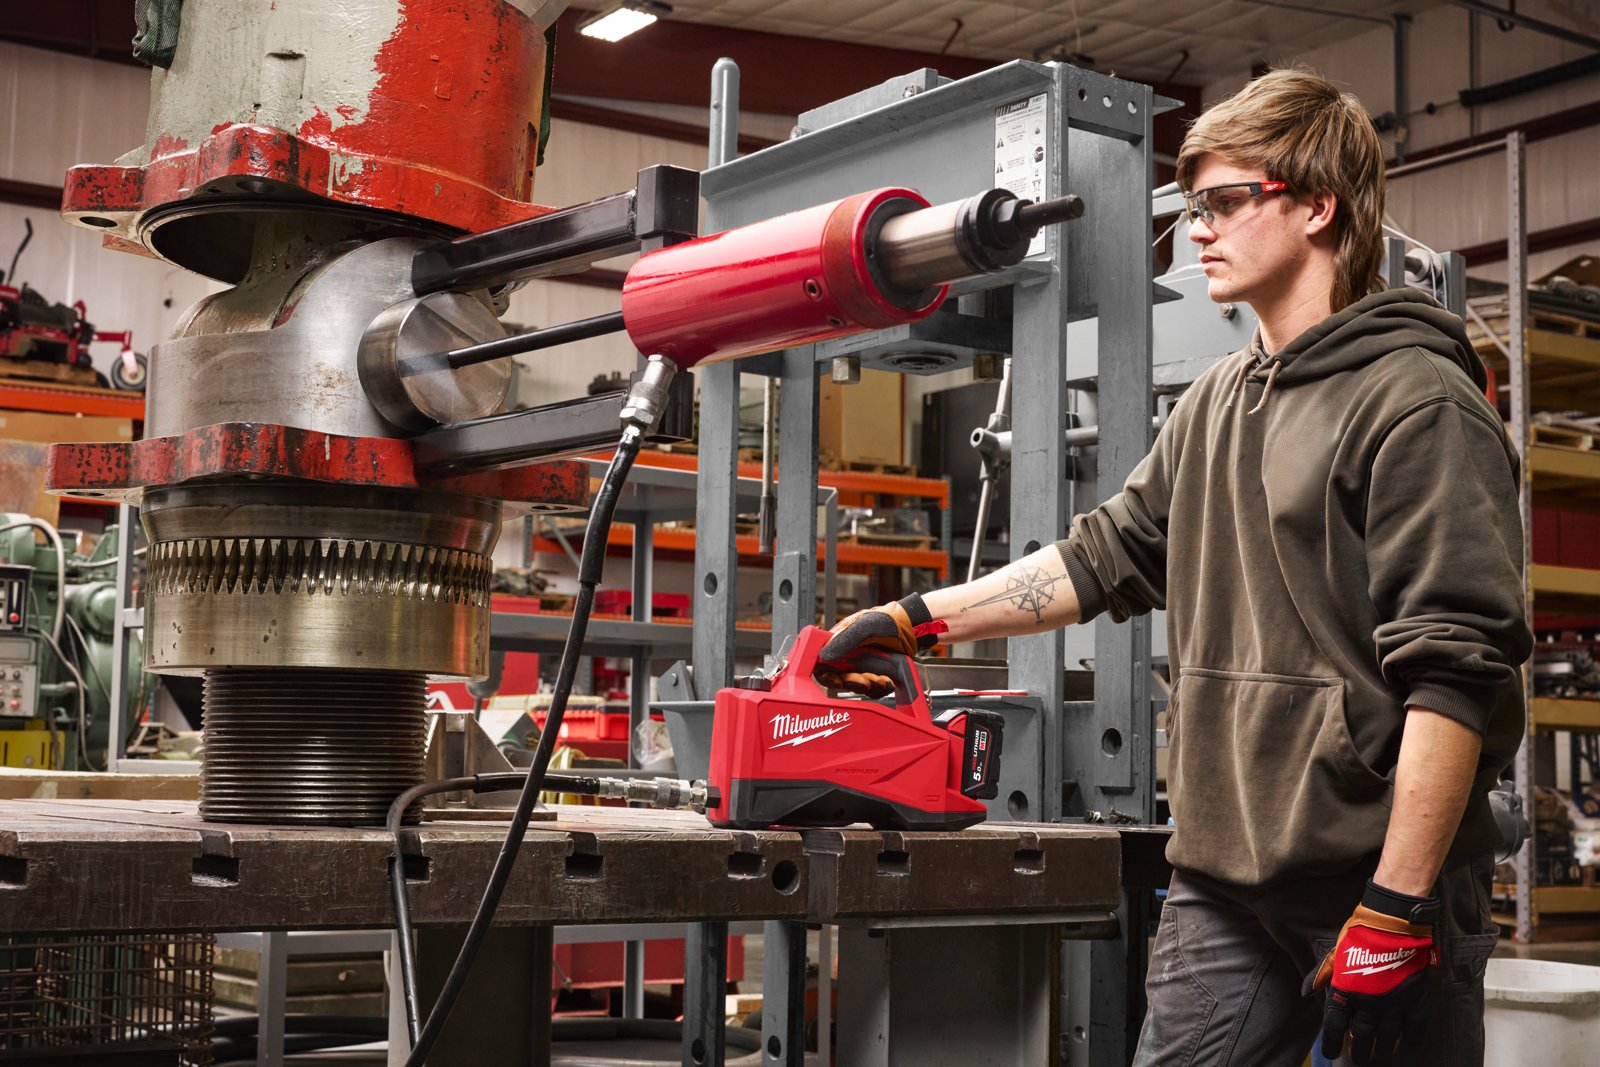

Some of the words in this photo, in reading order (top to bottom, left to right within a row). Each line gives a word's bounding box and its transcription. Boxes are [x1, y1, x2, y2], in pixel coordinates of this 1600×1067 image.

[1010, 101, 1027, 111] SAFETY
[769, 709, 850, 739] Milwaukee
[1343, 946, 1417, 968] Milwaukee
